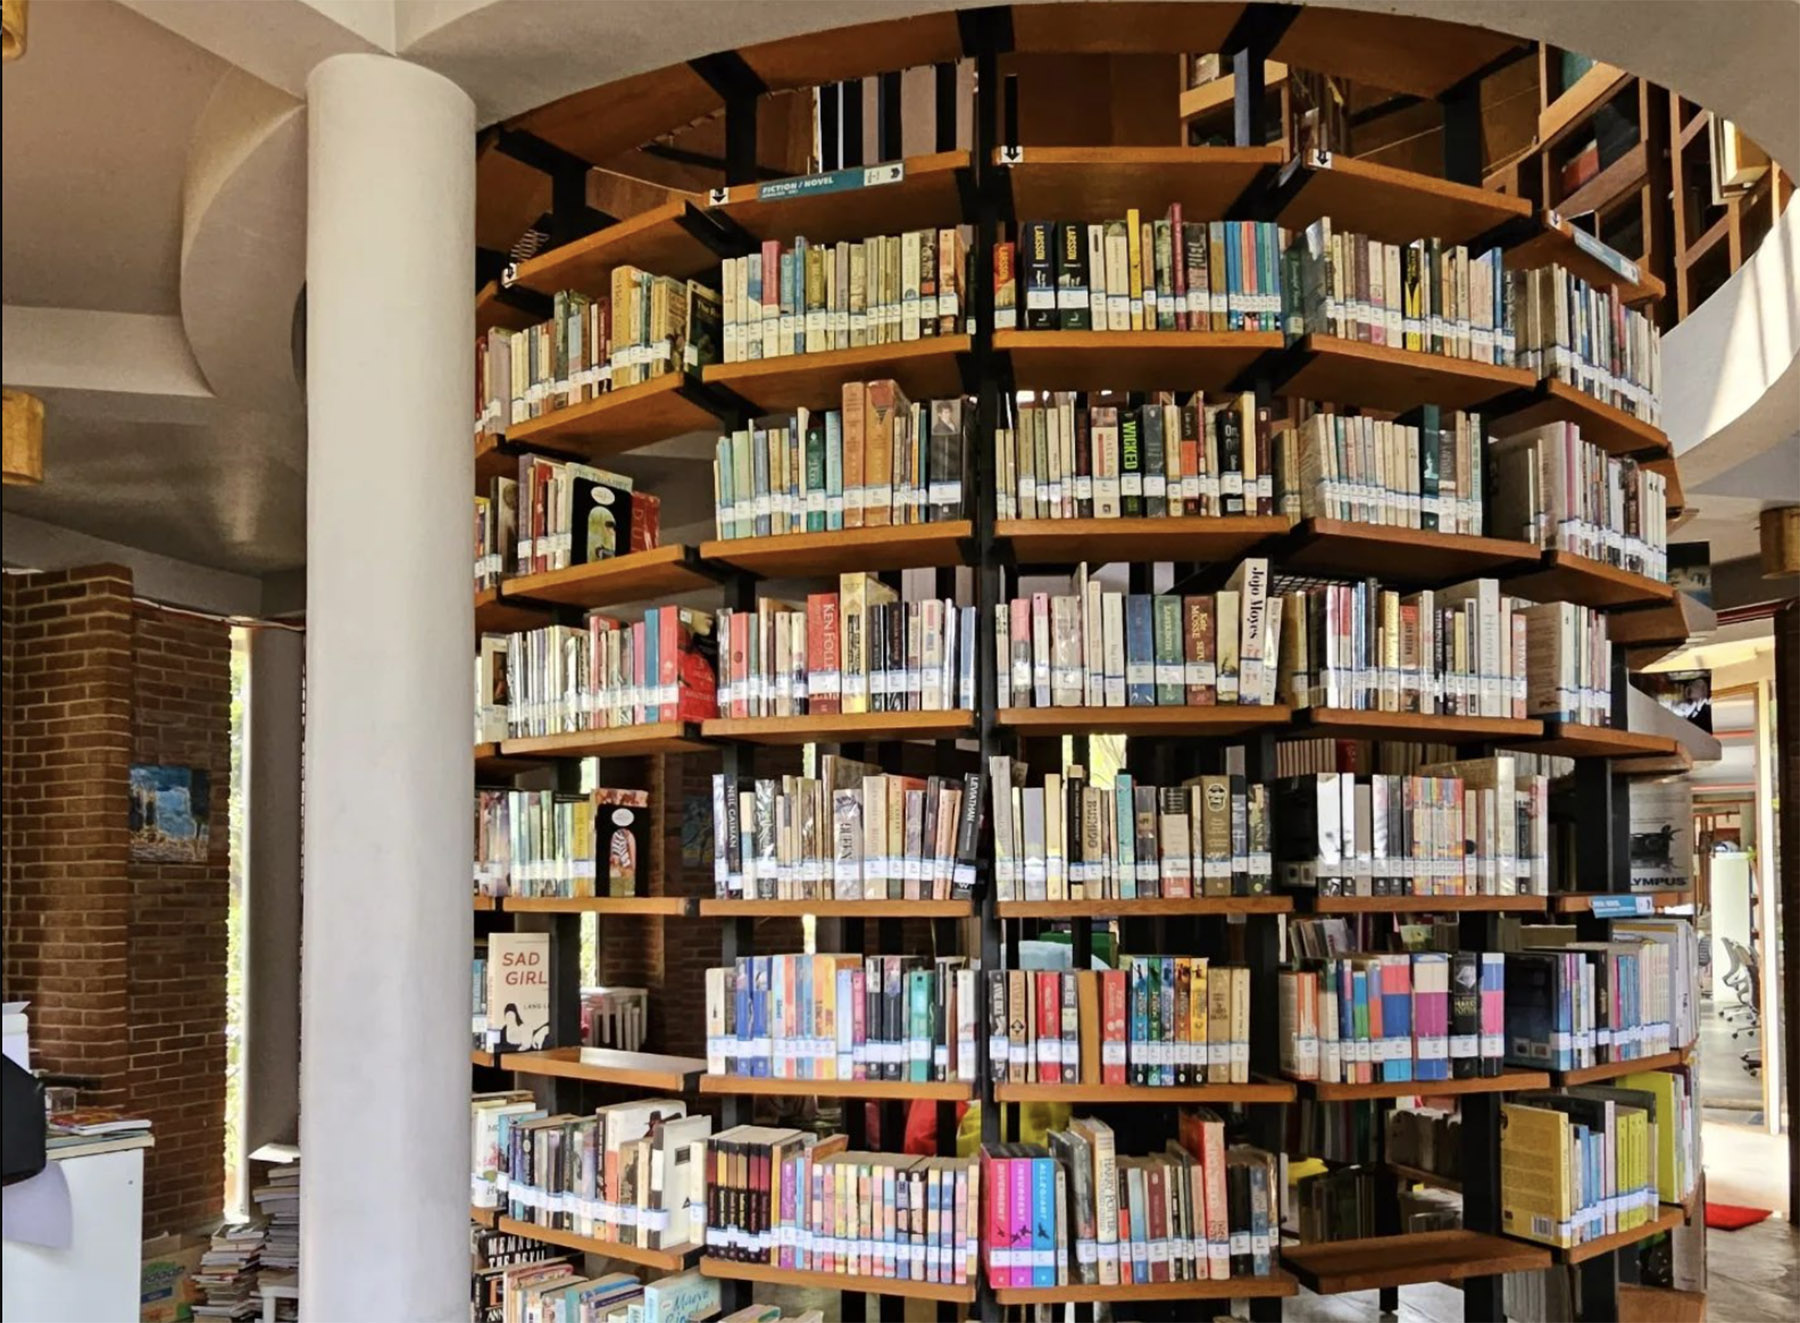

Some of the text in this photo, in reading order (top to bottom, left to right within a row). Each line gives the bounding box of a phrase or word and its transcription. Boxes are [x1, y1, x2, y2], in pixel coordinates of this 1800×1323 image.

[762, 182, 797, 195] FICTION
[804, 176, 834, 188] NOVEL
[1034, 225, 1046, 260] LARSSON
[1066, 225, 1077, 260] LARSSON
[1122, 421, 1138, 470] WICKED
[1248, 567, 1264, 596] Jojo
[823, 603, 835, 628] KEN
[1247, 600, 1263, 639] Moyes
[967, 776, 979, 822] LEVIATHAN
[728, 810, 738, 848] GAIMAN
[1086, 800, 1098, 849] BUSHIDO
[502, 952, 541, 967] SAD
[505, 970, 547, 985] GIRL
[997, 1163, 1005, 1222] DIVERGENT
[1017, 1163, 1025, 1221] INSURGENT
[1039, 1163, 1047, 1219] ALLEGIANT
[1103, 1158, 1116, 1234] HARRY POTTER
